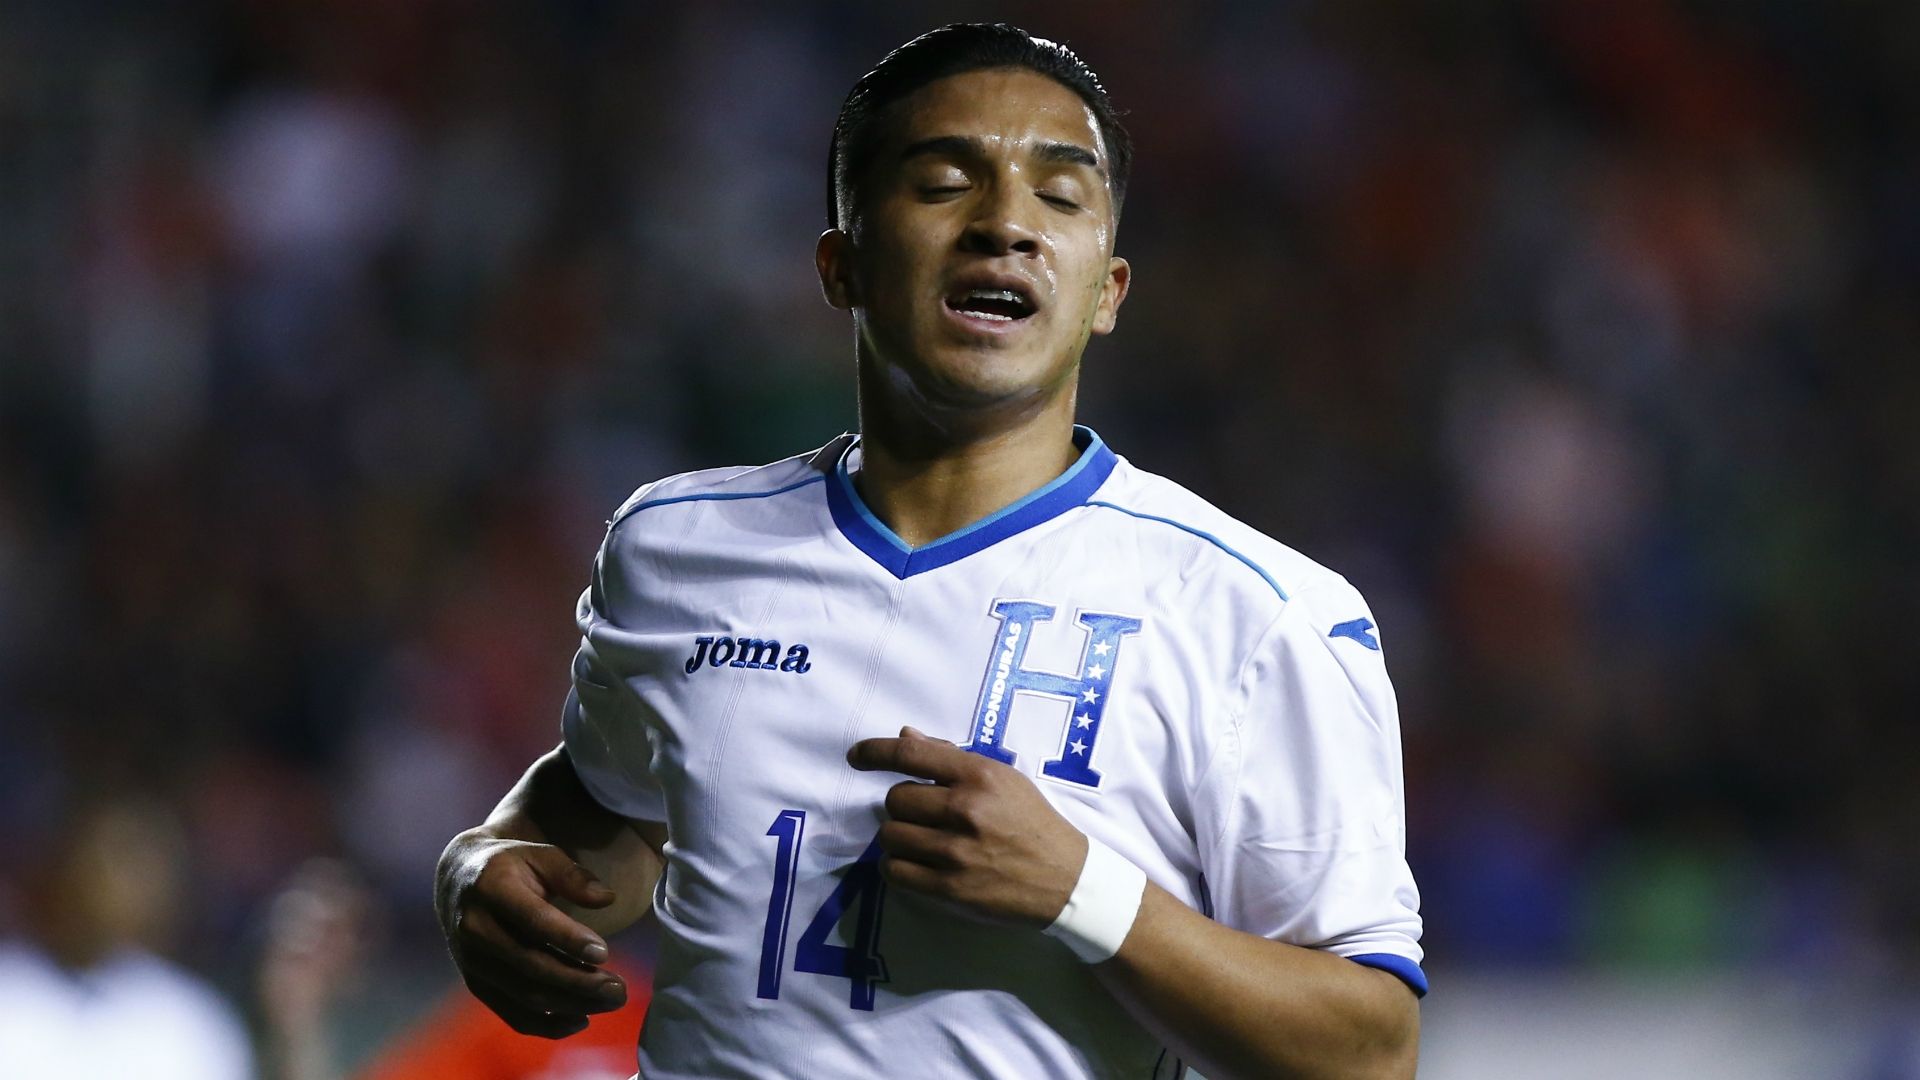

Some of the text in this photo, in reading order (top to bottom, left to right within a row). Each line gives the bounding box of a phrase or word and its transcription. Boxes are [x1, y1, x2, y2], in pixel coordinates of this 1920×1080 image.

[685, 636, 811, 674] Joma
[958, 600, 1142, 788] H
[980, 622, 1021, 745] HONDURAS
[757, 809, 890, 1011] 14
